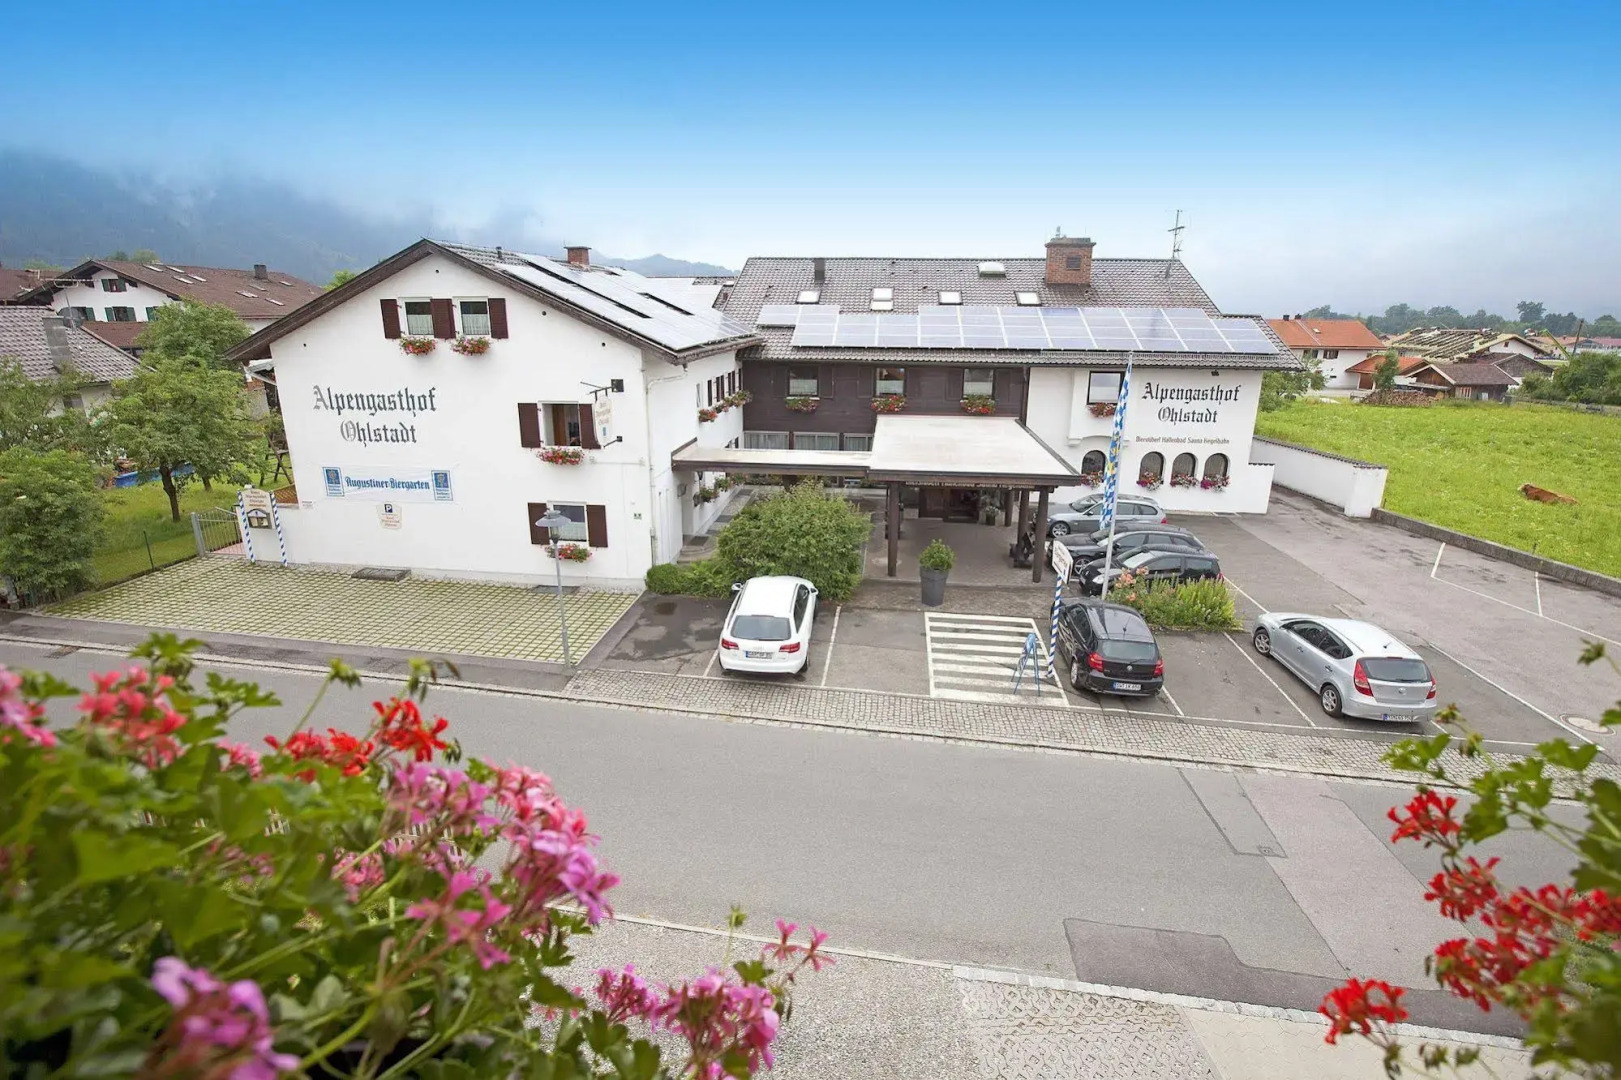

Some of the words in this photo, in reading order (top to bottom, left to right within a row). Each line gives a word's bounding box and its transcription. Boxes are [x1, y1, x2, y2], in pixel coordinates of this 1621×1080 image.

[313, 385, 436, 417] Alpengasthof
[1142, 382, 1242, 405] Alpengasthof
[1158, 406, 1218, 425] Ohlstadt
[340, 419, 417, 447] Ohlstadt
[345, 476, 389, 489] Augustiner
[389, 477, 430, 490] Biergarten
[385, 504, 392, 513] P
